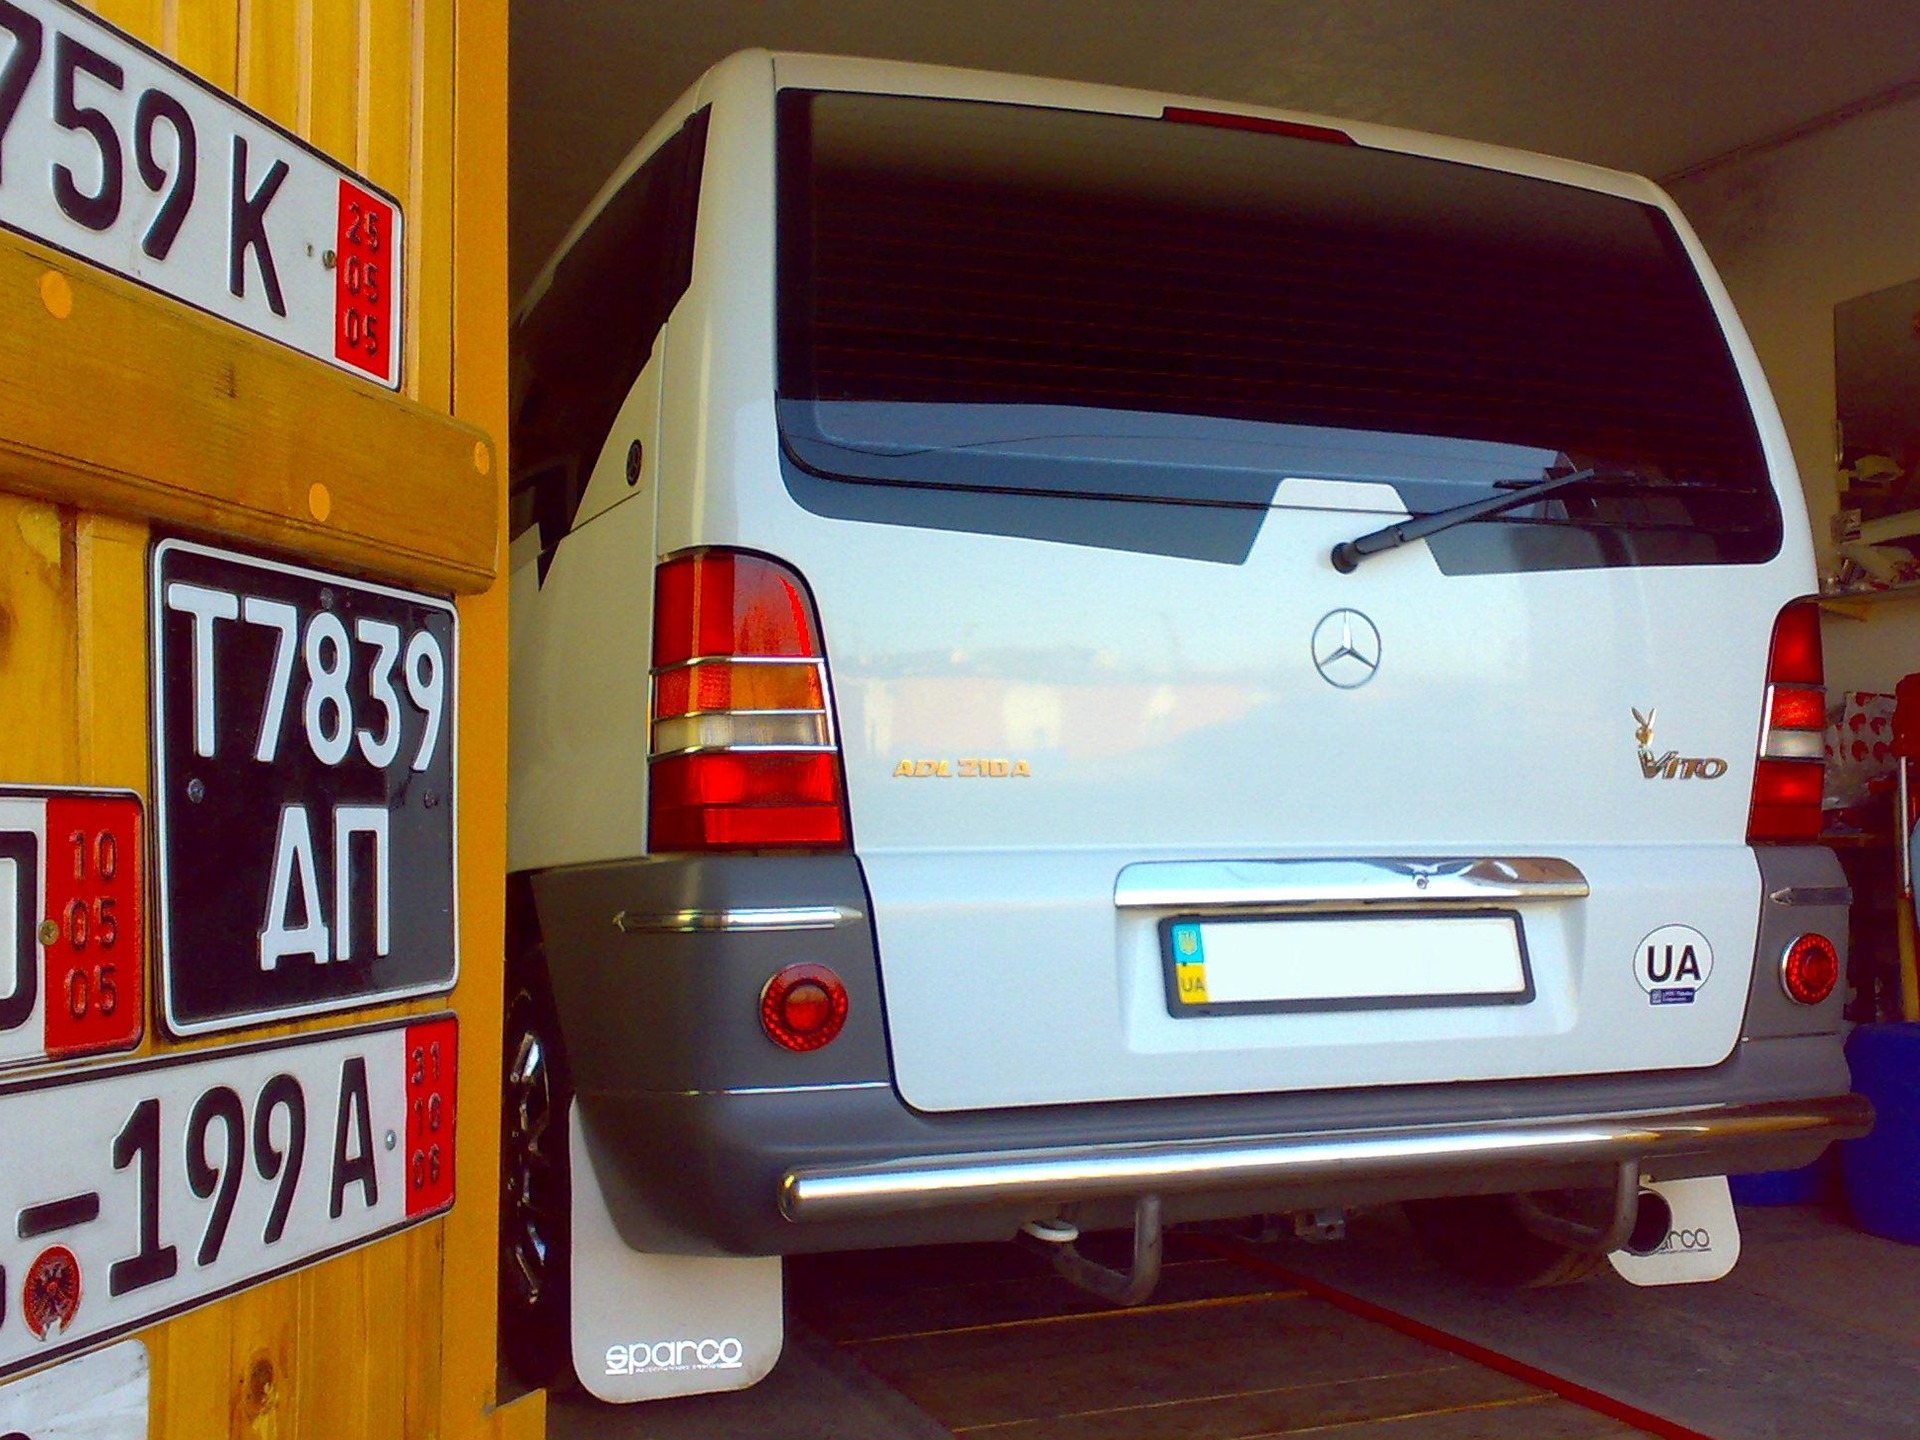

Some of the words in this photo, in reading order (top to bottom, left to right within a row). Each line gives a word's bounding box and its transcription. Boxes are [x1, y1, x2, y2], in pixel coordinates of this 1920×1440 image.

[345, 202, 379, 251] 25
[343, 255, 378, 303] 05
[343, 308, 378, 356] 05
[69, 829, 118, 881] 10
[259, 804, 389, 971] ДП
[63, 897, 118, 950] 05
[1181, 976, 1205, 992] UA
[1647, 944, 1701, 982] UA
[63, 963, 118, 1018] 05
[329, 1056, 379, 1219] A
[605, 1337, 743, 1375] sparco
